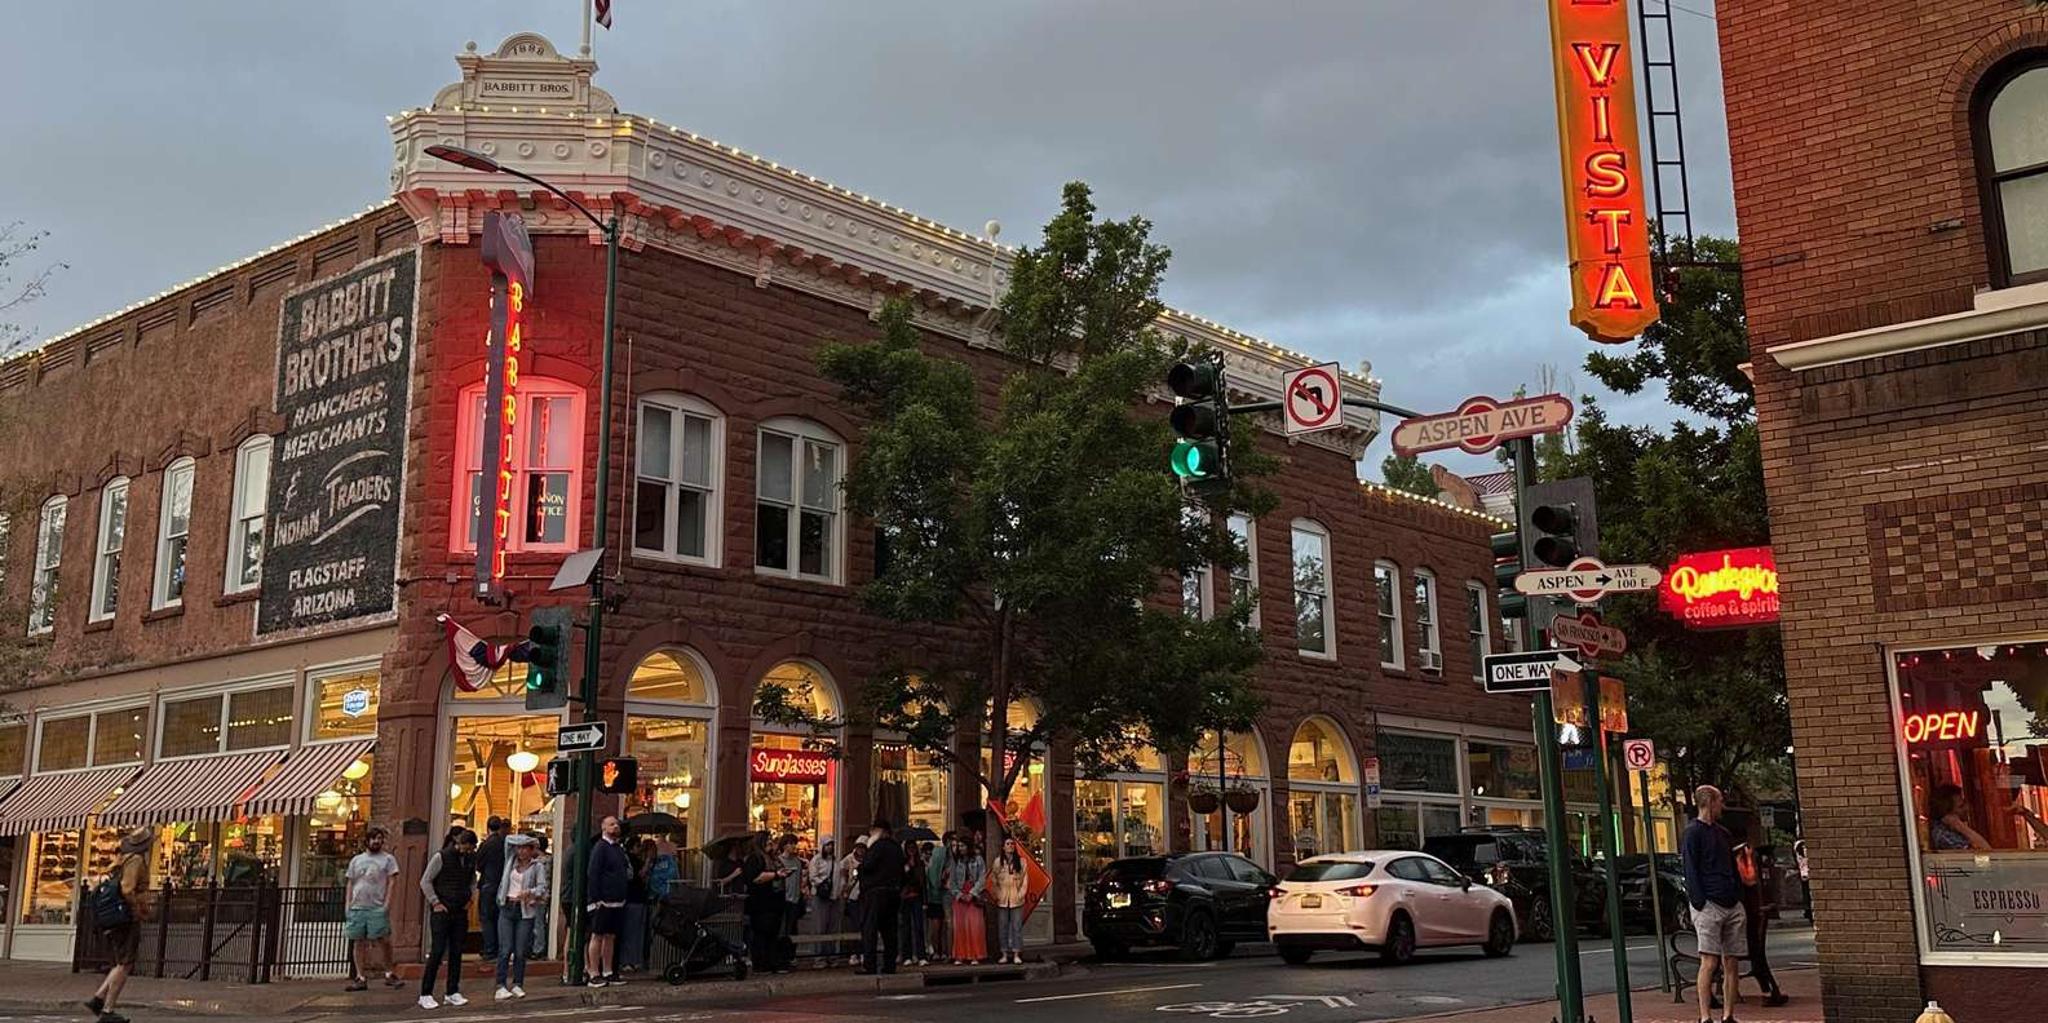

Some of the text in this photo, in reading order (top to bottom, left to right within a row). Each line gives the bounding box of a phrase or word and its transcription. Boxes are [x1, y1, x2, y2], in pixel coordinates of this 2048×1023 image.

[484, 82, 537, 93] BABBITT
[1571, 43, 1642, 309] VISTA
[299, 267, 396, 342] BABBITT
[285, 316, 403, 397] BROTHERS
[282, 408, 388, 461] MERCHANTS
[1416, 405, 1546, 445] ASPEN AVE
[288, 556, 367, 591] FLAGSTAFF
[1537, 575, 1584, 590] ASPEN
[1614, 568, 1637, 578] AVE
[1617, 578, 1648, 589] 100 E
[291, 588, 355, 618] ARIZONA
[1685, 602, 1727, 618] coffee
[1728, 599, 1739, 615] &
[1496, 665, 1523, 680] ONE
[562, 731, 591, 744] ONE WAY
[1904, 711, 1977, 743] OPEN
[753, 751, 827, 777] Sunglasses
[1973, 890, 2040, 910] ESPRESSO
